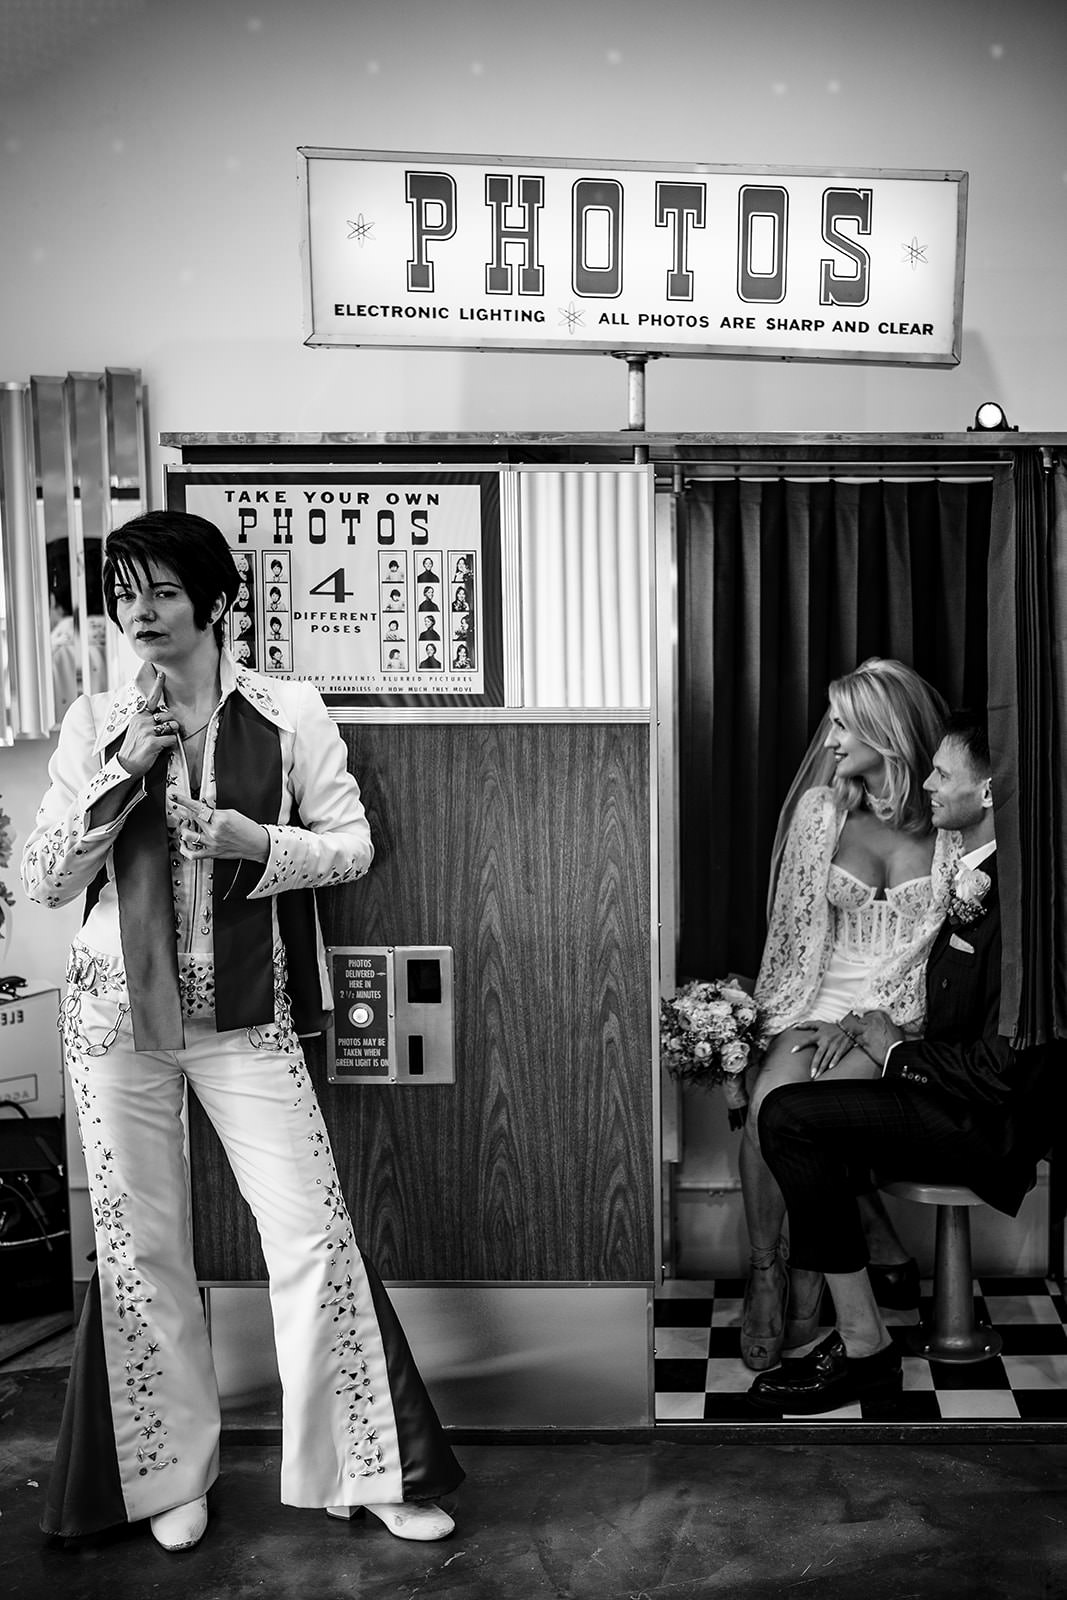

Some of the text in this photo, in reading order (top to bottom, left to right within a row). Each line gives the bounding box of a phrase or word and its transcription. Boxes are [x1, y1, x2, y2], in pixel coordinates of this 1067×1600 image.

[405, 170, 876, 308] PHOTOS
[334, 303, 935, 336] ELECTRONIC LIGHTING ALL PHOTOS ARE SHARP AND CLEAR
[224, 490, 440, 506] TAKE YOUR OWN
[238, 507, 429, 546] PHOTOS
[309, 567, 354, 603] 4
[294, 612, 377, 621] DIFFERENT
[310, 624, 362, 634] POSES
[348, 959, 372, 968] PHOTOS
[345, 969, 376, 978] DELIVERED
[348, 980, 372, 988] HERE IN
[356, 990, 382, 998] MINUTES
[338, 1038, 386, 1046] PHOTOS MAY BE
[343, 1048, 381, 1056] TAKEN WHEN
[336, 1058, 390, 1067] GREEN LIGHT IS ON
